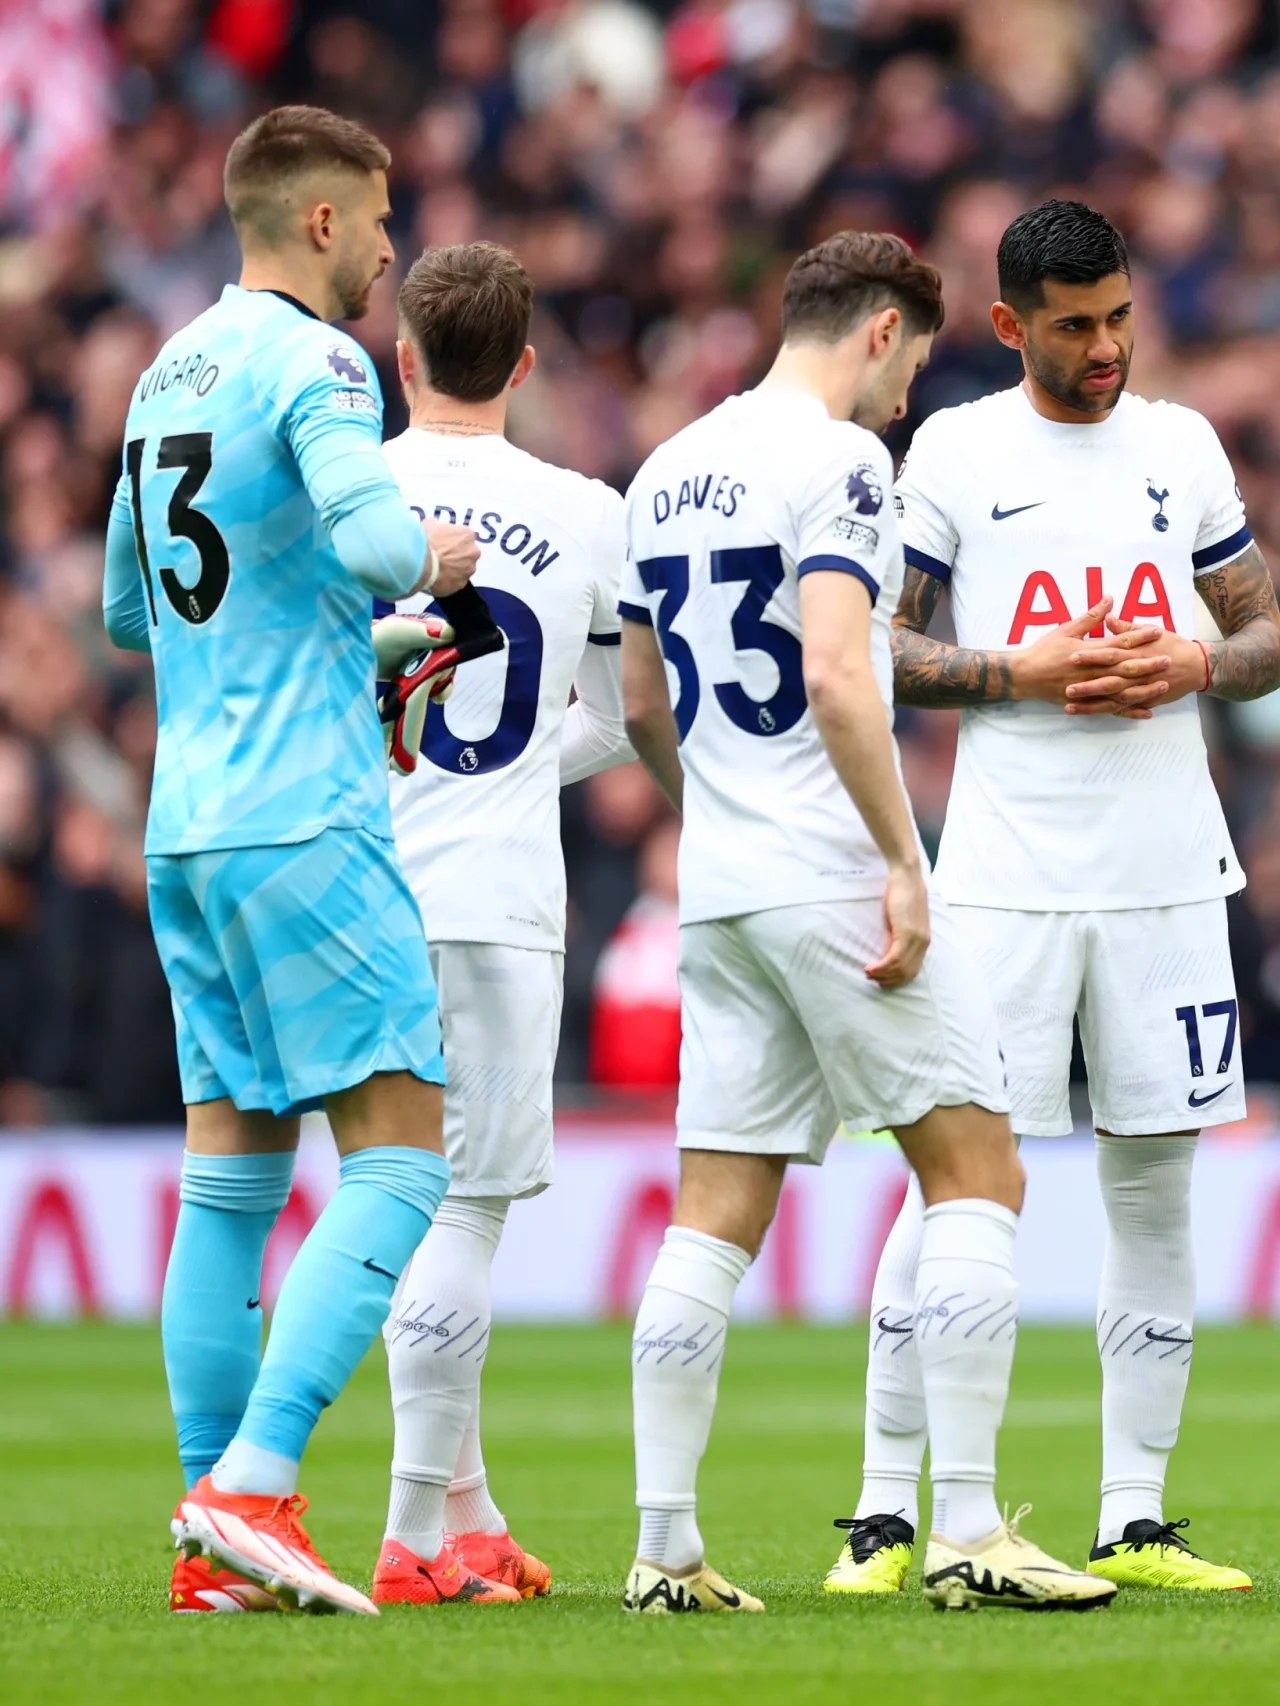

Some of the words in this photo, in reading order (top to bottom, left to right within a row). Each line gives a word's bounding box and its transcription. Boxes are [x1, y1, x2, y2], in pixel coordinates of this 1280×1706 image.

[140, 353, 220, 403] VICARIO
[126, 431, 231, 627] 13
[636, 545, 811, 746] 33
[1007, 561, 1178, 646] AIA
[1175, 998, 1238, 1078] 17
